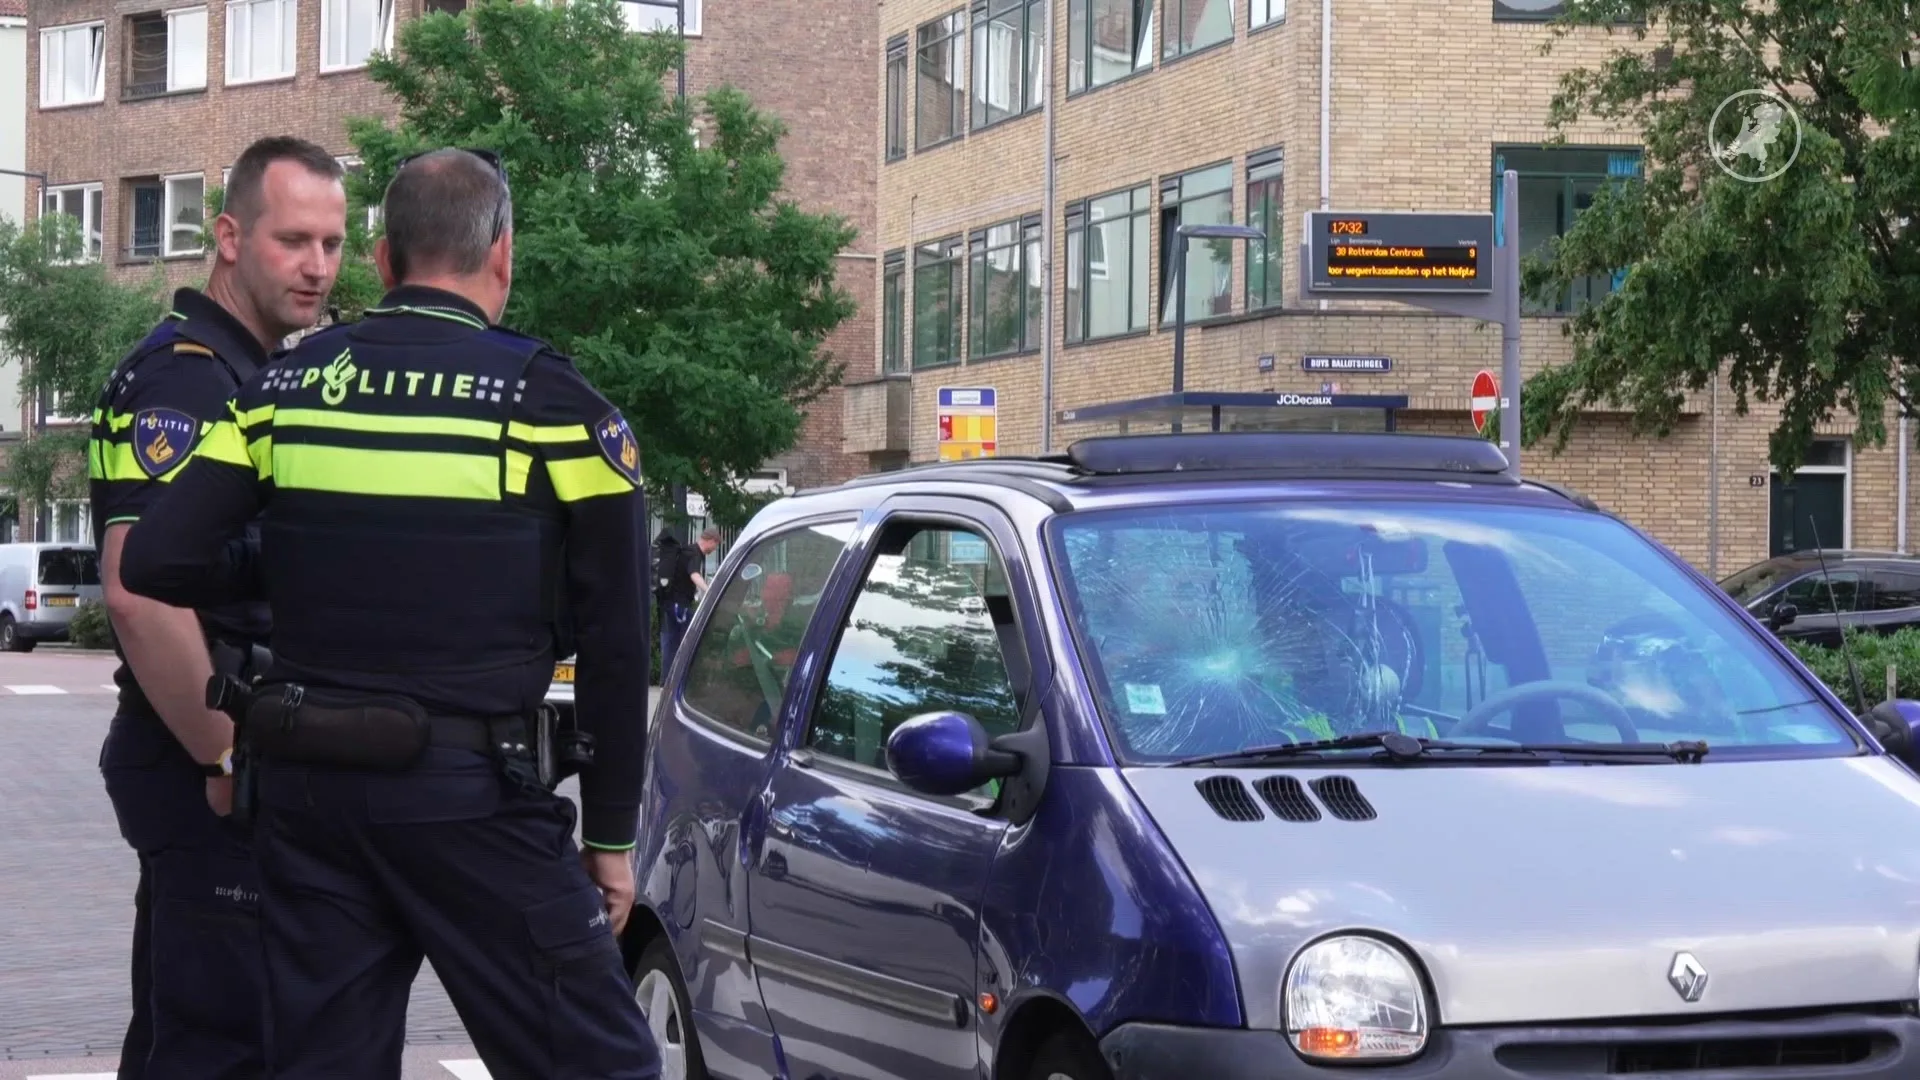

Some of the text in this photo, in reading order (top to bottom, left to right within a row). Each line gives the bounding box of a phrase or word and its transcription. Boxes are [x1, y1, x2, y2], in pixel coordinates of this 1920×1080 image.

[1332, 222, 1362, 234] 17:32
[1348, 246, 1388, 257] Rotterdam
[1390, 247, 1424, 257] Centraal
[1469, 248, 1476, 258] 9
[1345, 265, 1419, 278] wegwerkzaamheden
[1421, 267, 1431, 278] op
[1433, 266, 1446, 276] het
[1311, 359, 1383, 369] BUYS BALLOTSINGEL
[301, 348, 474, 405] POLITIE
[1277, 394, 1332, 405] JCDecaux
[140, 413, 190, 433] POLITIE
